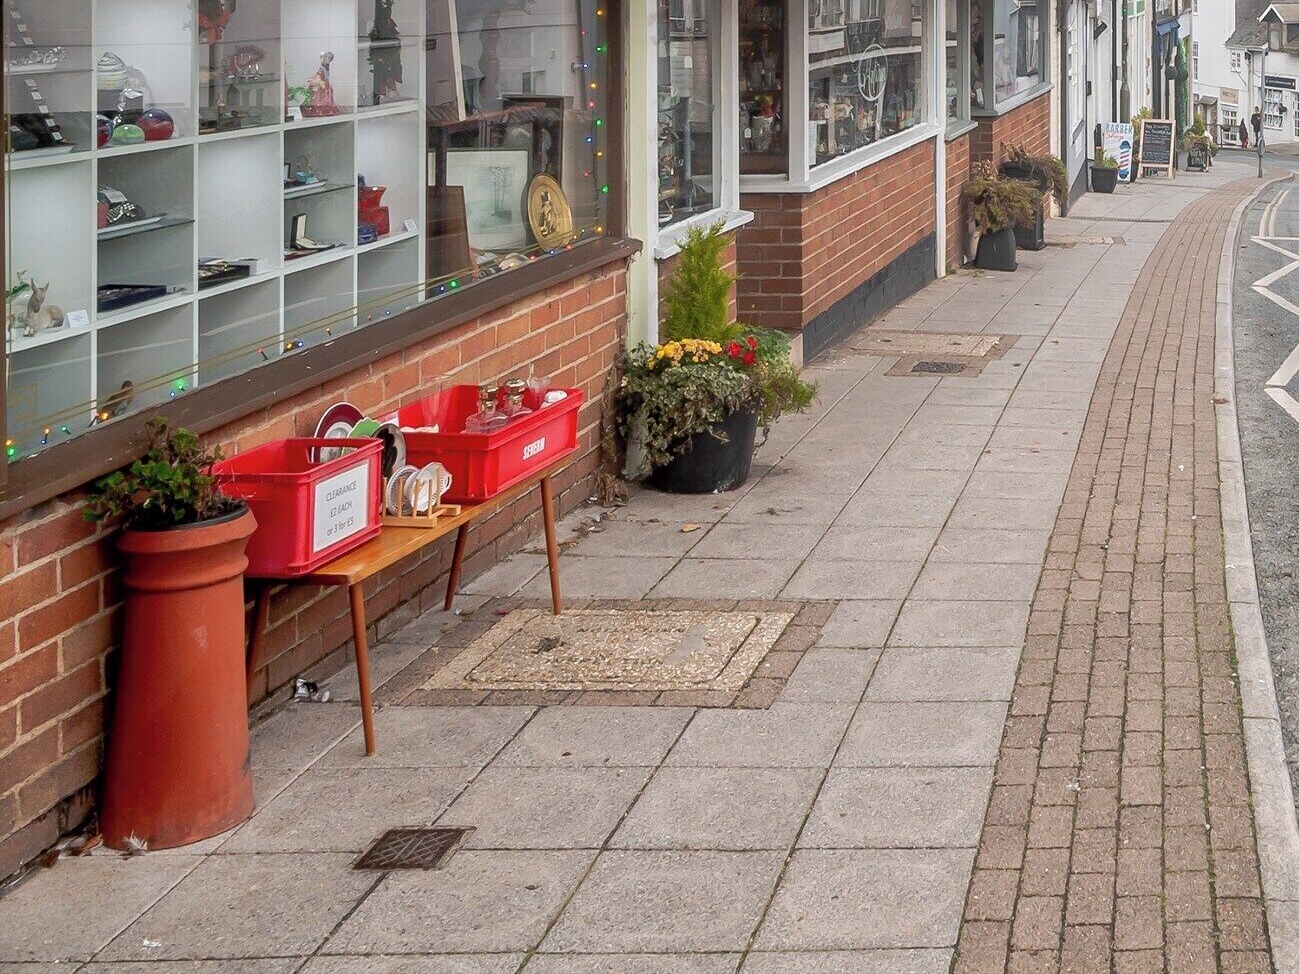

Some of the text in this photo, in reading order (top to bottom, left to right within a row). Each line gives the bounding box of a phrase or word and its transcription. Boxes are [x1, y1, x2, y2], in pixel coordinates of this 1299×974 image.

[1106, 123, 1133, 134] BARBER
[1106, 131, 1124, 142] Shop
[326, 480, 357, 502] CLEARANCE
[338, 500, 353, 514] EACH
[327, 528, 333, 536] or
[339, 522, 347, 530] for
